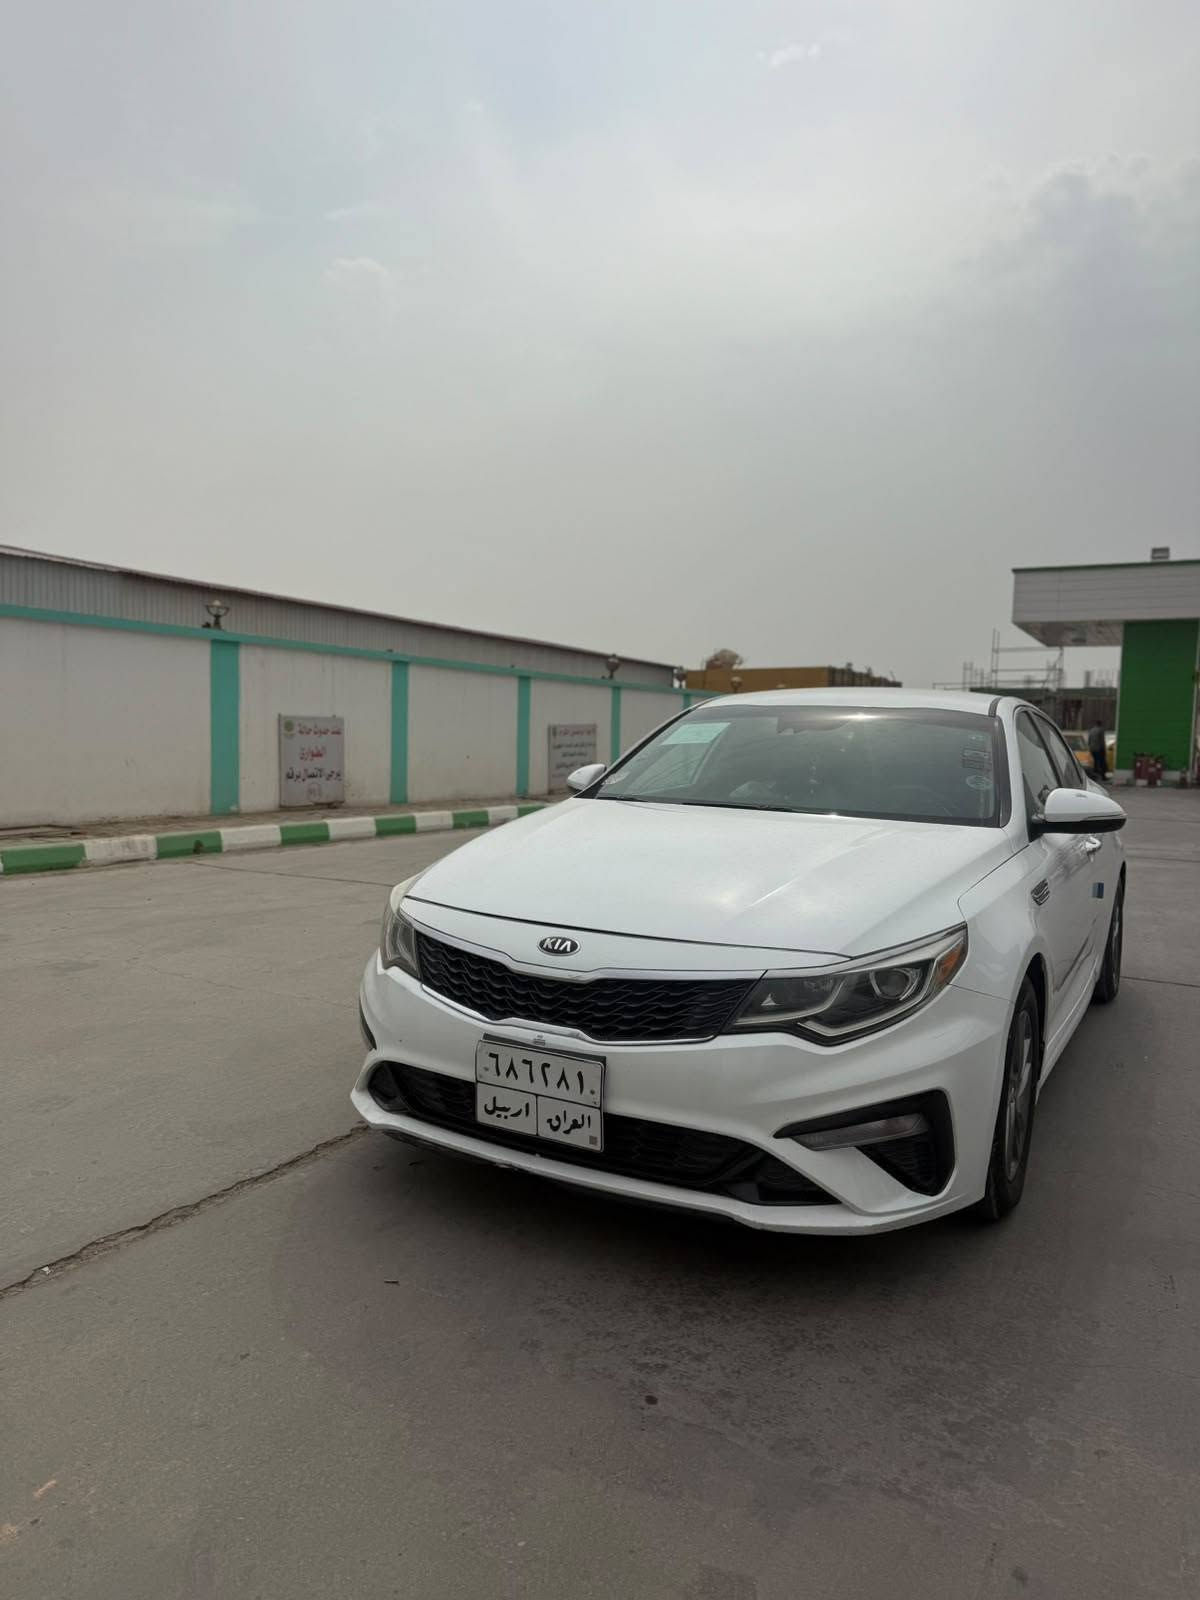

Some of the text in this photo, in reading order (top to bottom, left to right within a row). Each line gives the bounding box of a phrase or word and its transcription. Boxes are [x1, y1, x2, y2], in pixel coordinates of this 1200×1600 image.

[543, 938, 571, 952] KIA
[489, 1052, 584, 1095] ٦٨٦٢٨١
[546, 1110, 590, 1134] العراق
